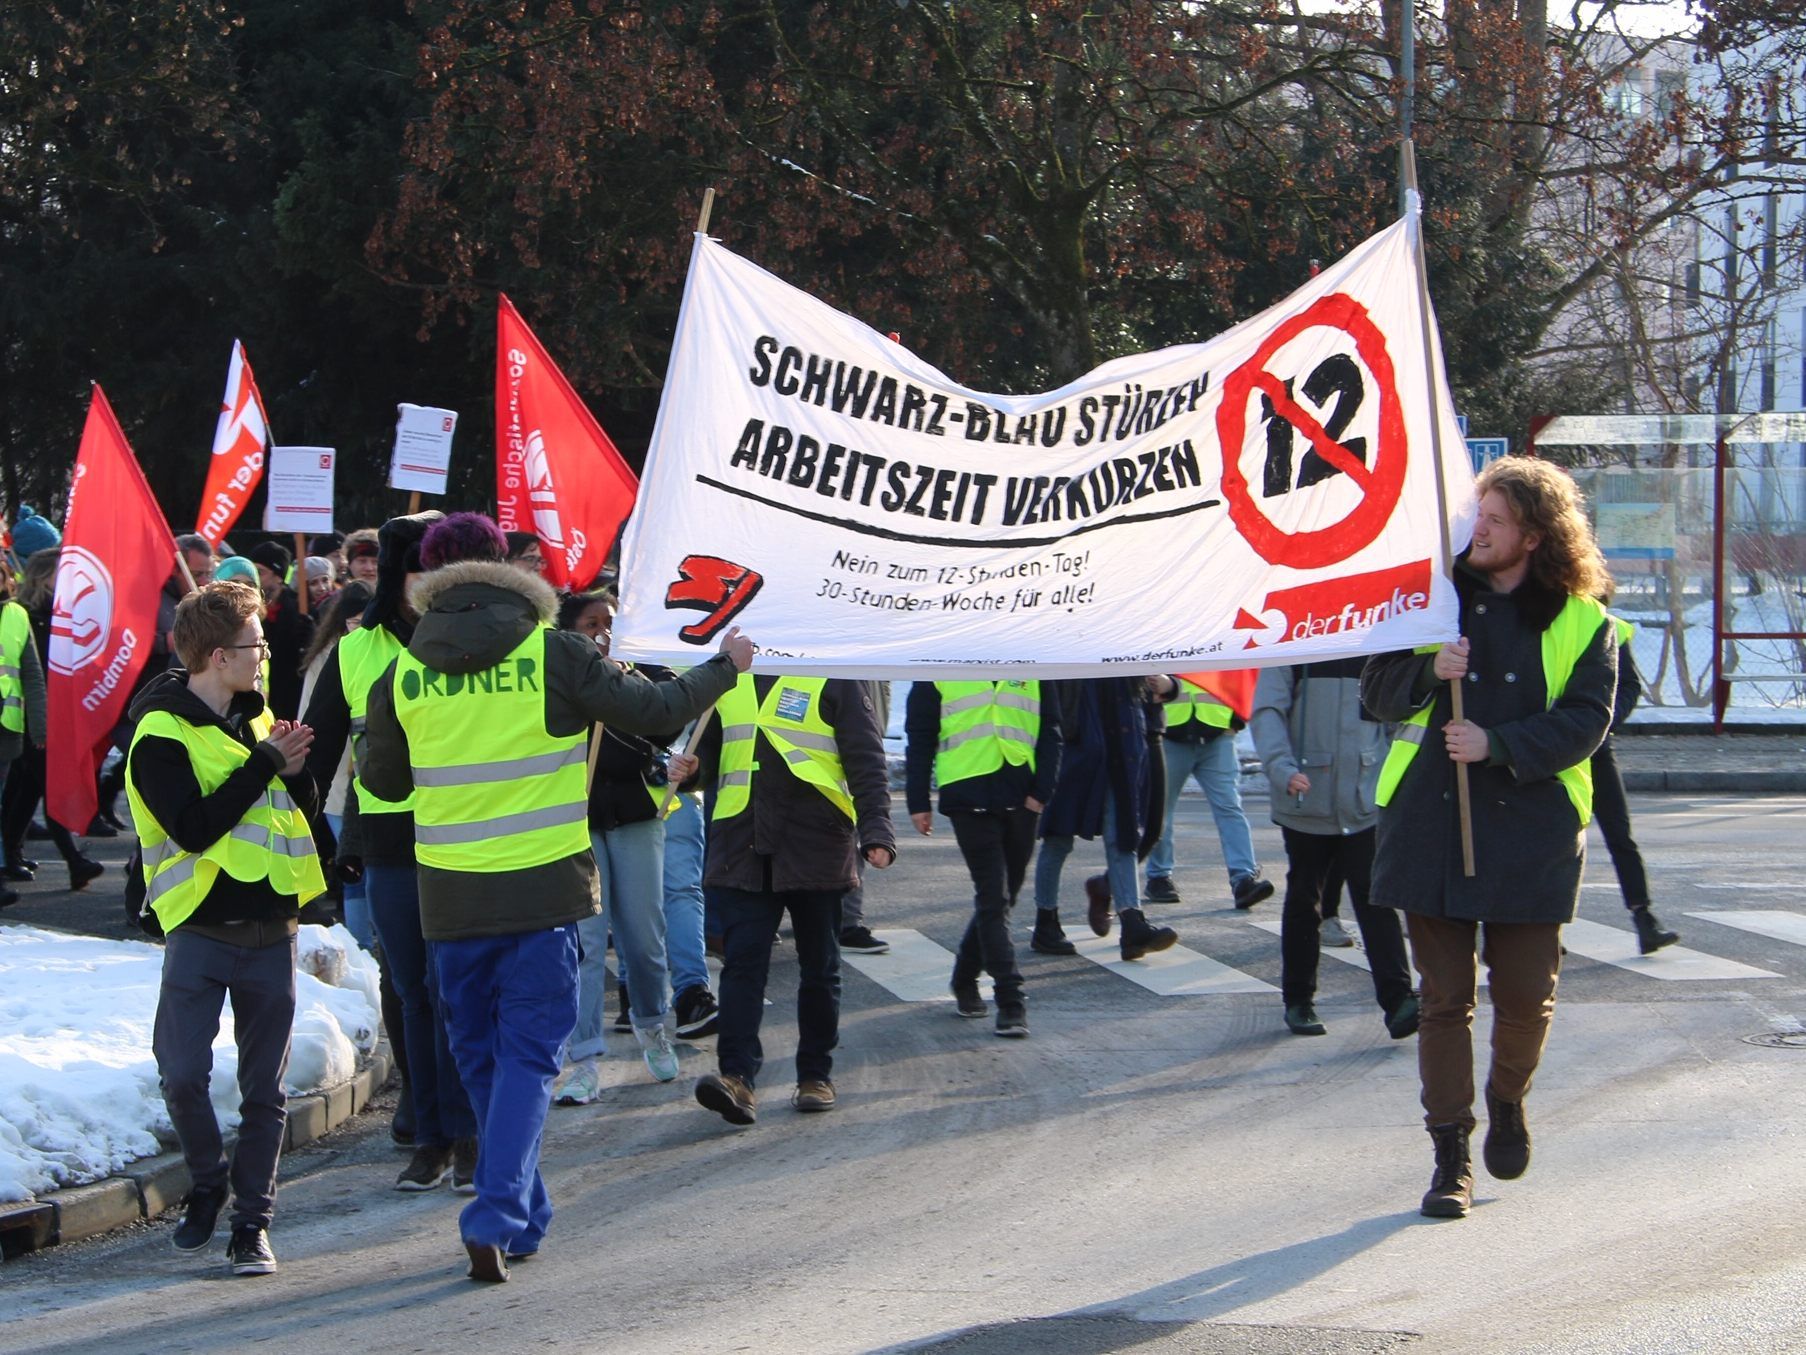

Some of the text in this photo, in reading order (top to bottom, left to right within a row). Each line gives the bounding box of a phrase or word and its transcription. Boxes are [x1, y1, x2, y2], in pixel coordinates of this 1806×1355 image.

[749, 335, 1210, 447] SCHWARZ-BLAU STÜRZEN
[1261, 353, 1365, 498] 12
[730, 418, 999, 526] ARBEITSZEIT
[831, 549, 878, 576] Nein
[887, 563, 928, 583] zum
[815, 578, 1096, 613] 30-Stunden-Woche für alle!
[1101, 641, 1224, 664] www.derfunke.at
[401, 657, 539, 701] ORDNER
